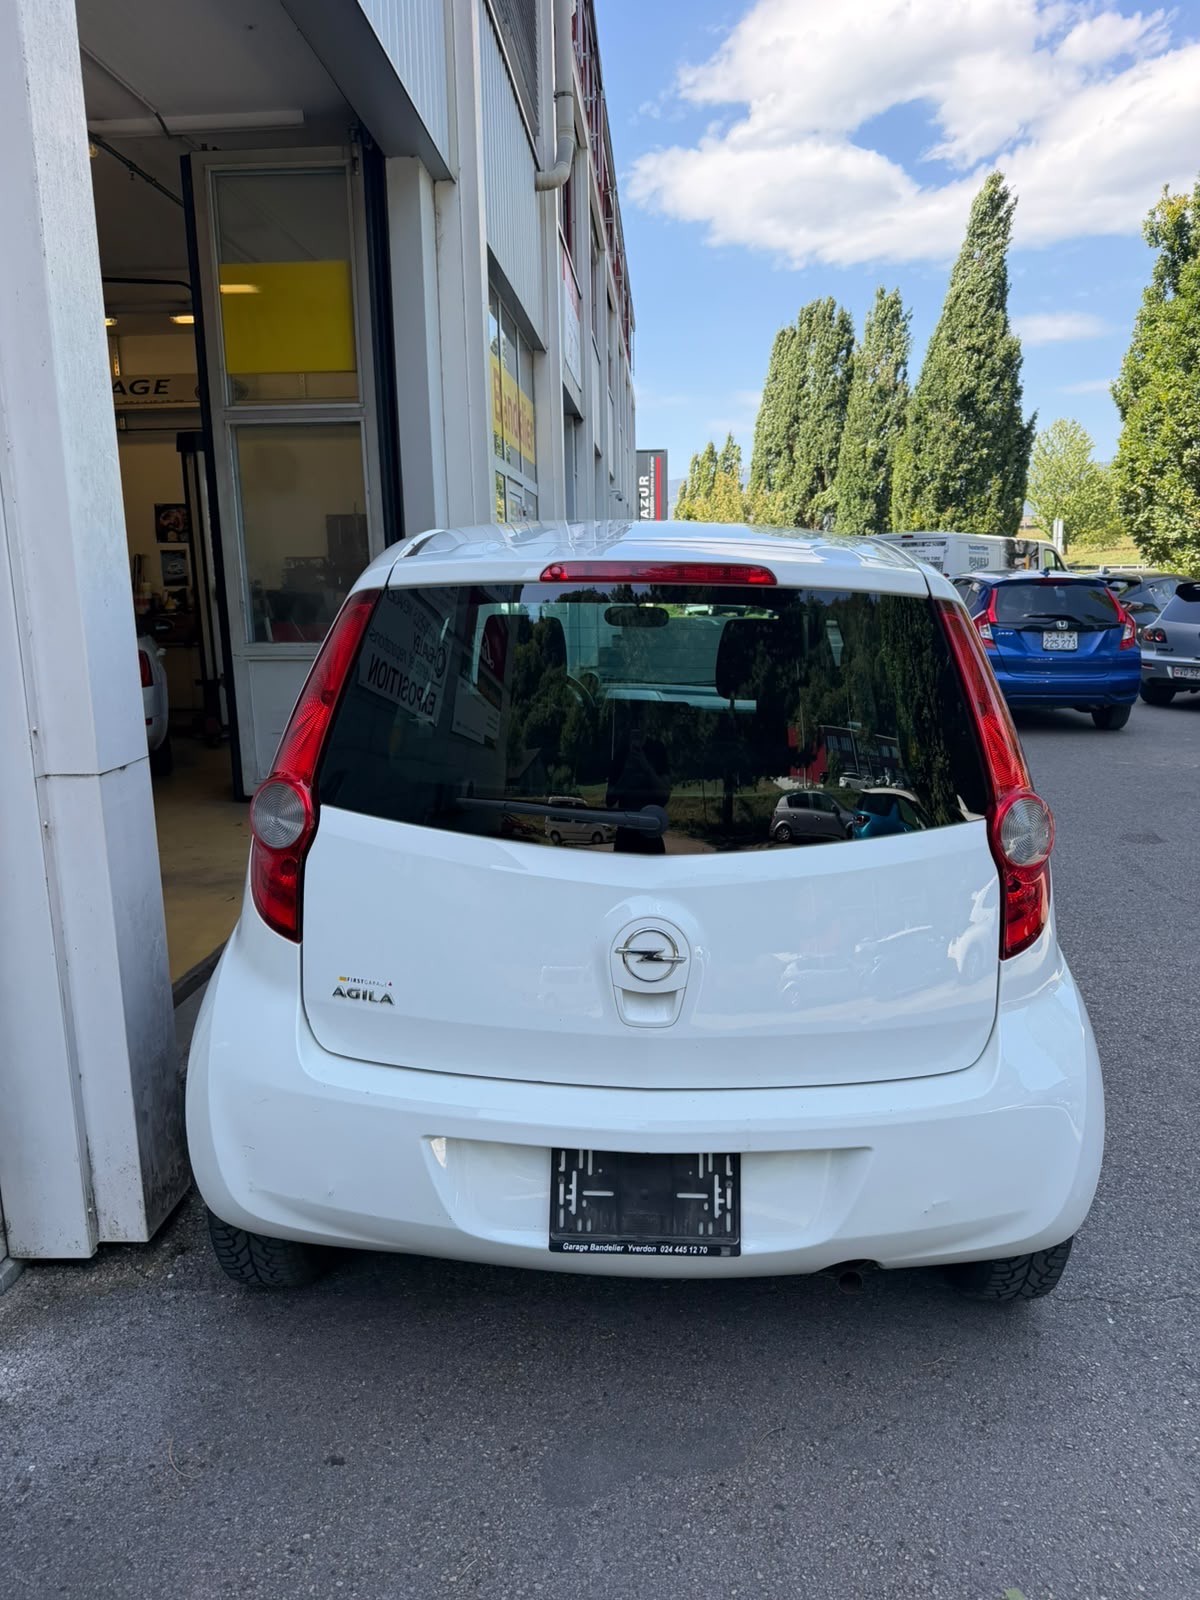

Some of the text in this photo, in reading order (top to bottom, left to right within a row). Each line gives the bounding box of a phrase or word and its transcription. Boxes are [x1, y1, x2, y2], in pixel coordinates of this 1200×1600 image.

[638, 475, 650, 519] AZUR
[332, 986, 395, 1006] AGILA
[562, 1242, 708, 1254] Garage Bandelier Yverdon 024 445 12 70
